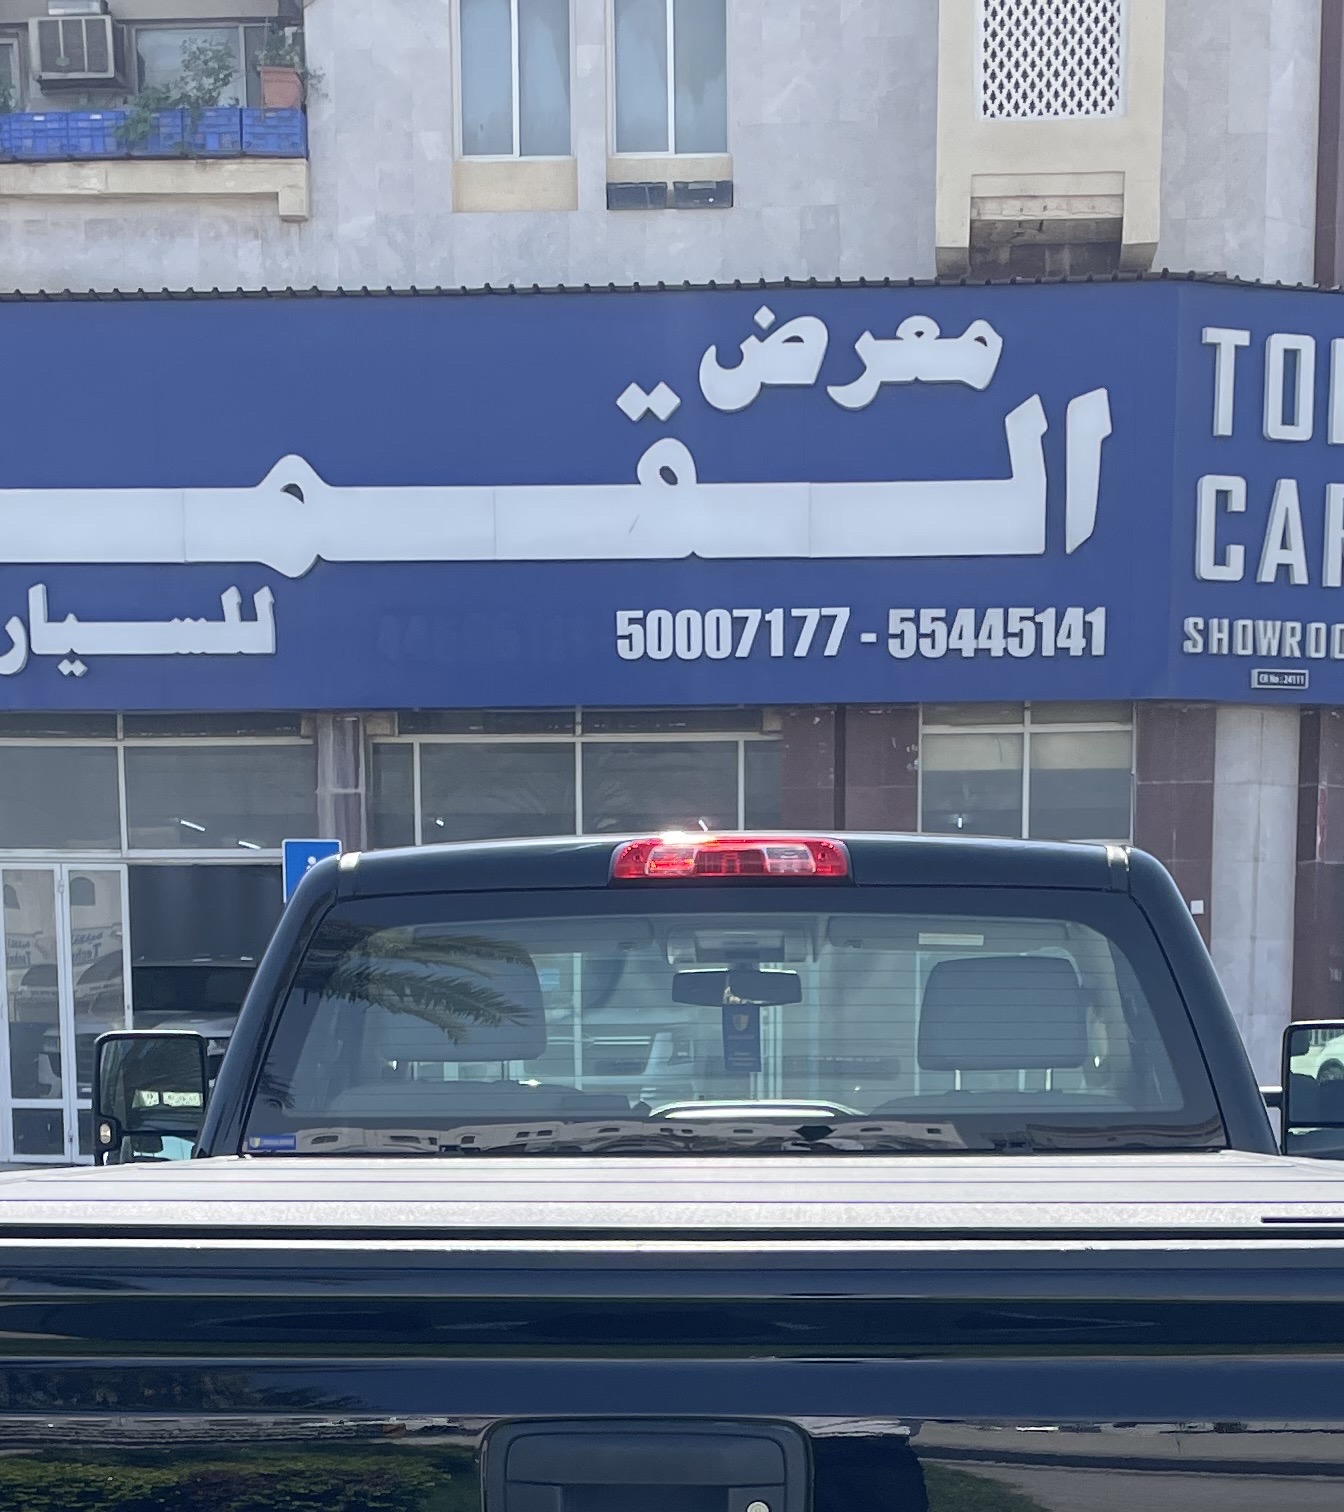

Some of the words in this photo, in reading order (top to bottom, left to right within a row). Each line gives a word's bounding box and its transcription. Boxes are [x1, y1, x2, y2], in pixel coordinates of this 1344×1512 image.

[699, 304, 1003, 412] معرض
[616, 607, 851, 660] 50007177
[887, 607, 1107, 660] 55445141
